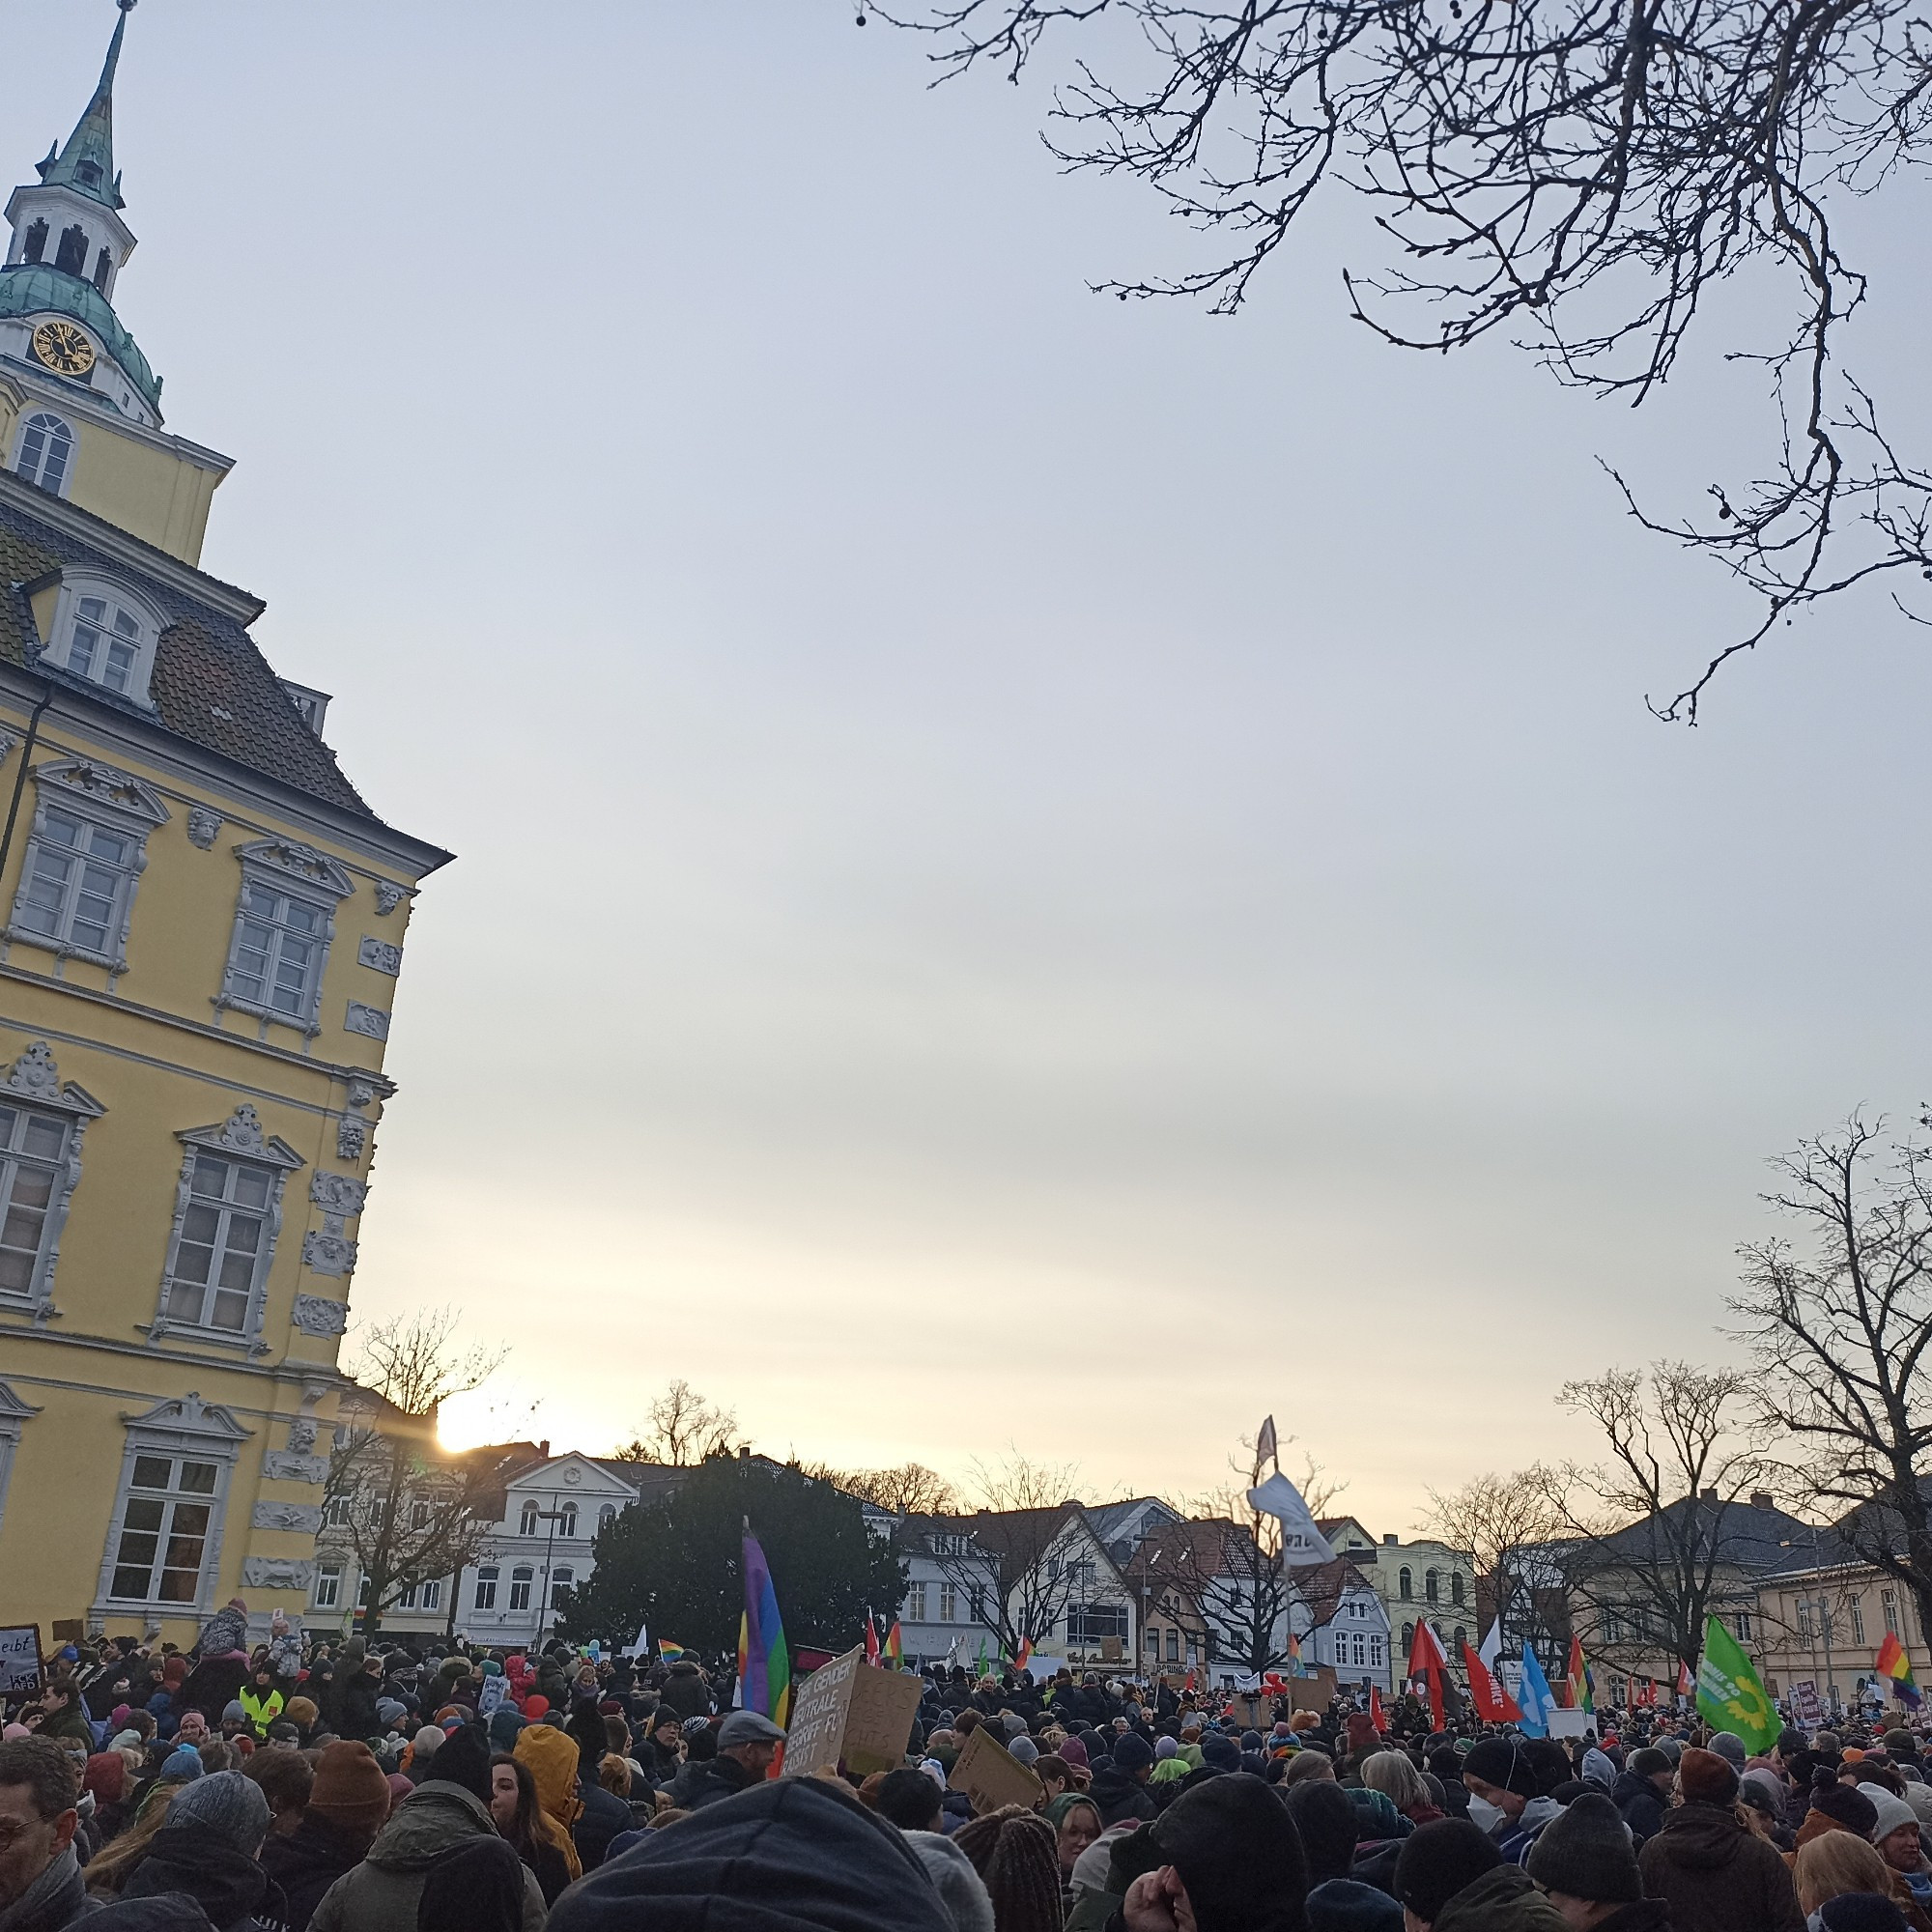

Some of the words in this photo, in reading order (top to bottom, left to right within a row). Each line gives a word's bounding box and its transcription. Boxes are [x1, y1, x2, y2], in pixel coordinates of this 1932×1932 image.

[13, 1673, 34, 1683] FCK
[14, 1681, 36, 1691] AFD
[786, 1719, 823, 1754] BEGRIFF
